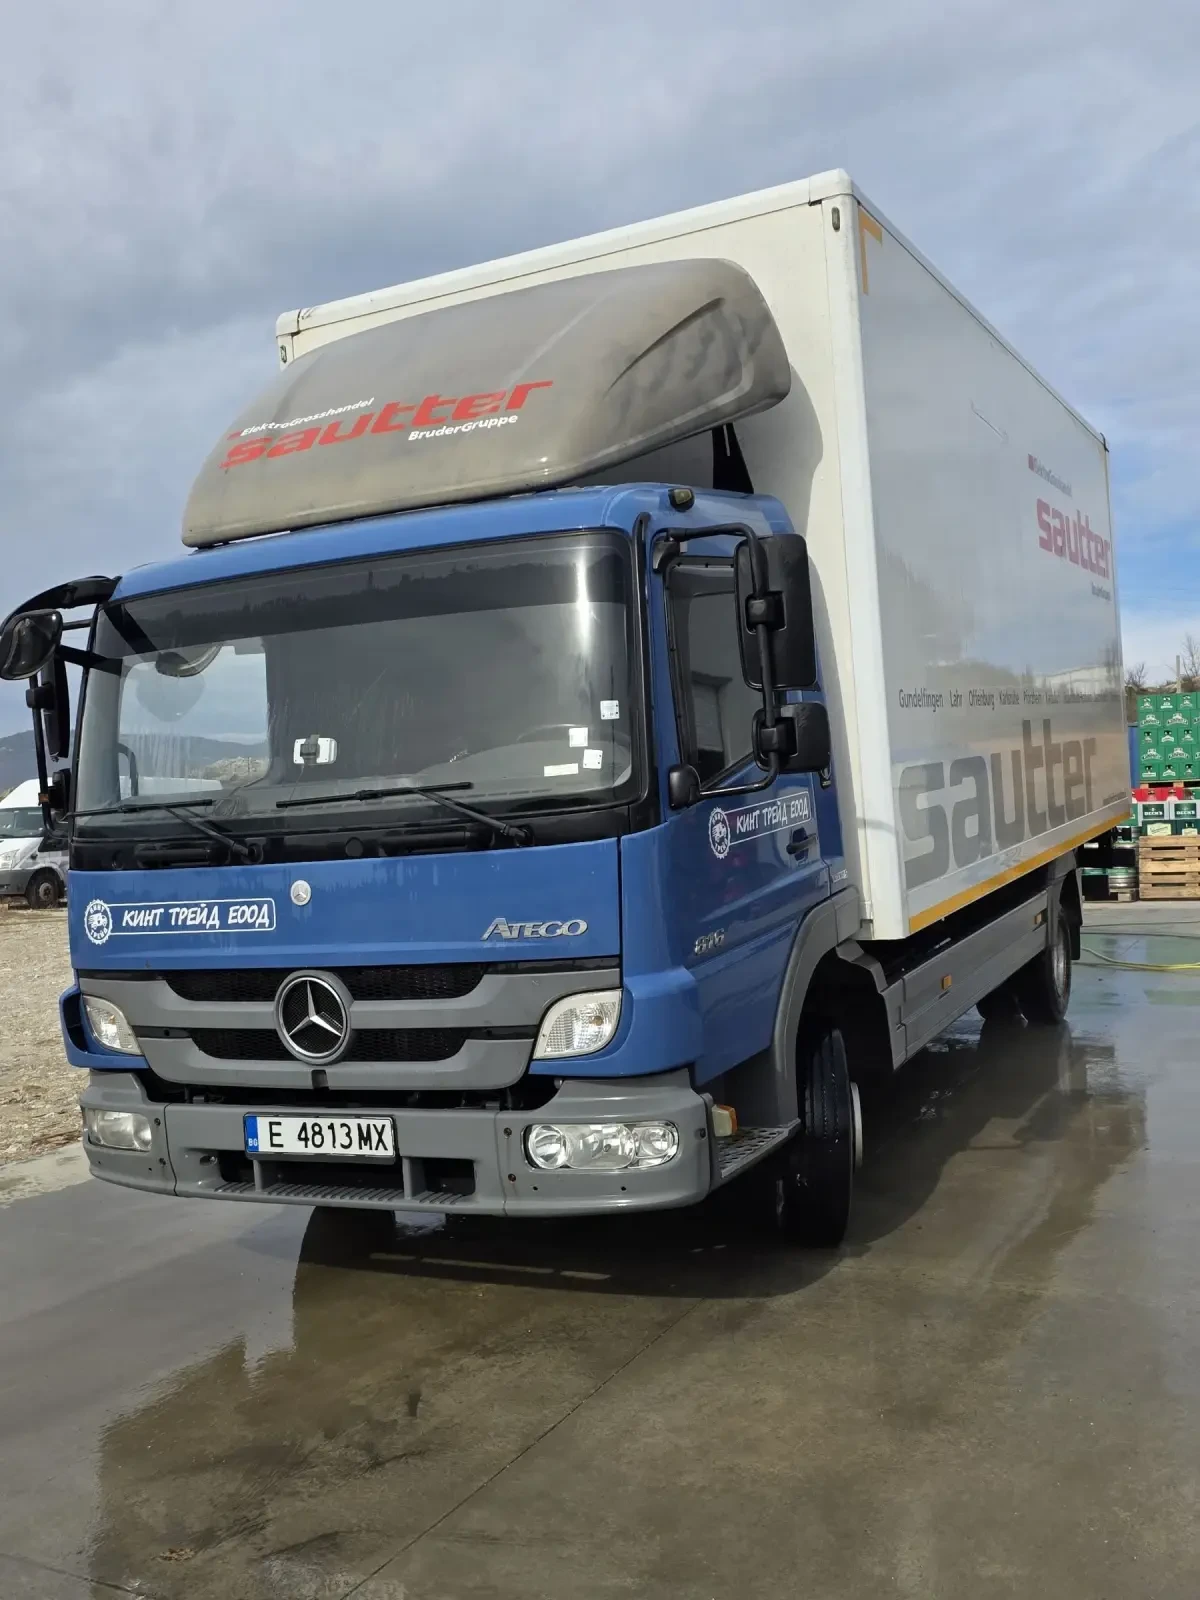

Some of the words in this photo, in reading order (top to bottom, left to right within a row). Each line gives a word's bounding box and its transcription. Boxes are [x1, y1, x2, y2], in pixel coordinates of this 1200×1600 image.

[219, 380, 553, 470] sautter
[239, 397, 374, 437] ElektroGrosshandel
[408, 414, 518, 441] BruderGruppe
[1037, 498, 1110, 580] sautter
[899, 687, 944, 713] Gundelfingen
[736, 809, 760, 834] КИНТ
[762, 802, 788, 826] ТРЕЙД
[790, 797, 809, 819] ЕООД
[899, 718, 1097, 890] sautter
[122, 908, 164, 927] КИНТ
[168, 903, 220, 930] ТРЕЙД
[228, 903, 270, 928] ЕООД
[248, 1138, 258, 1147] BG
[268, 1121, 284, 1148] E
